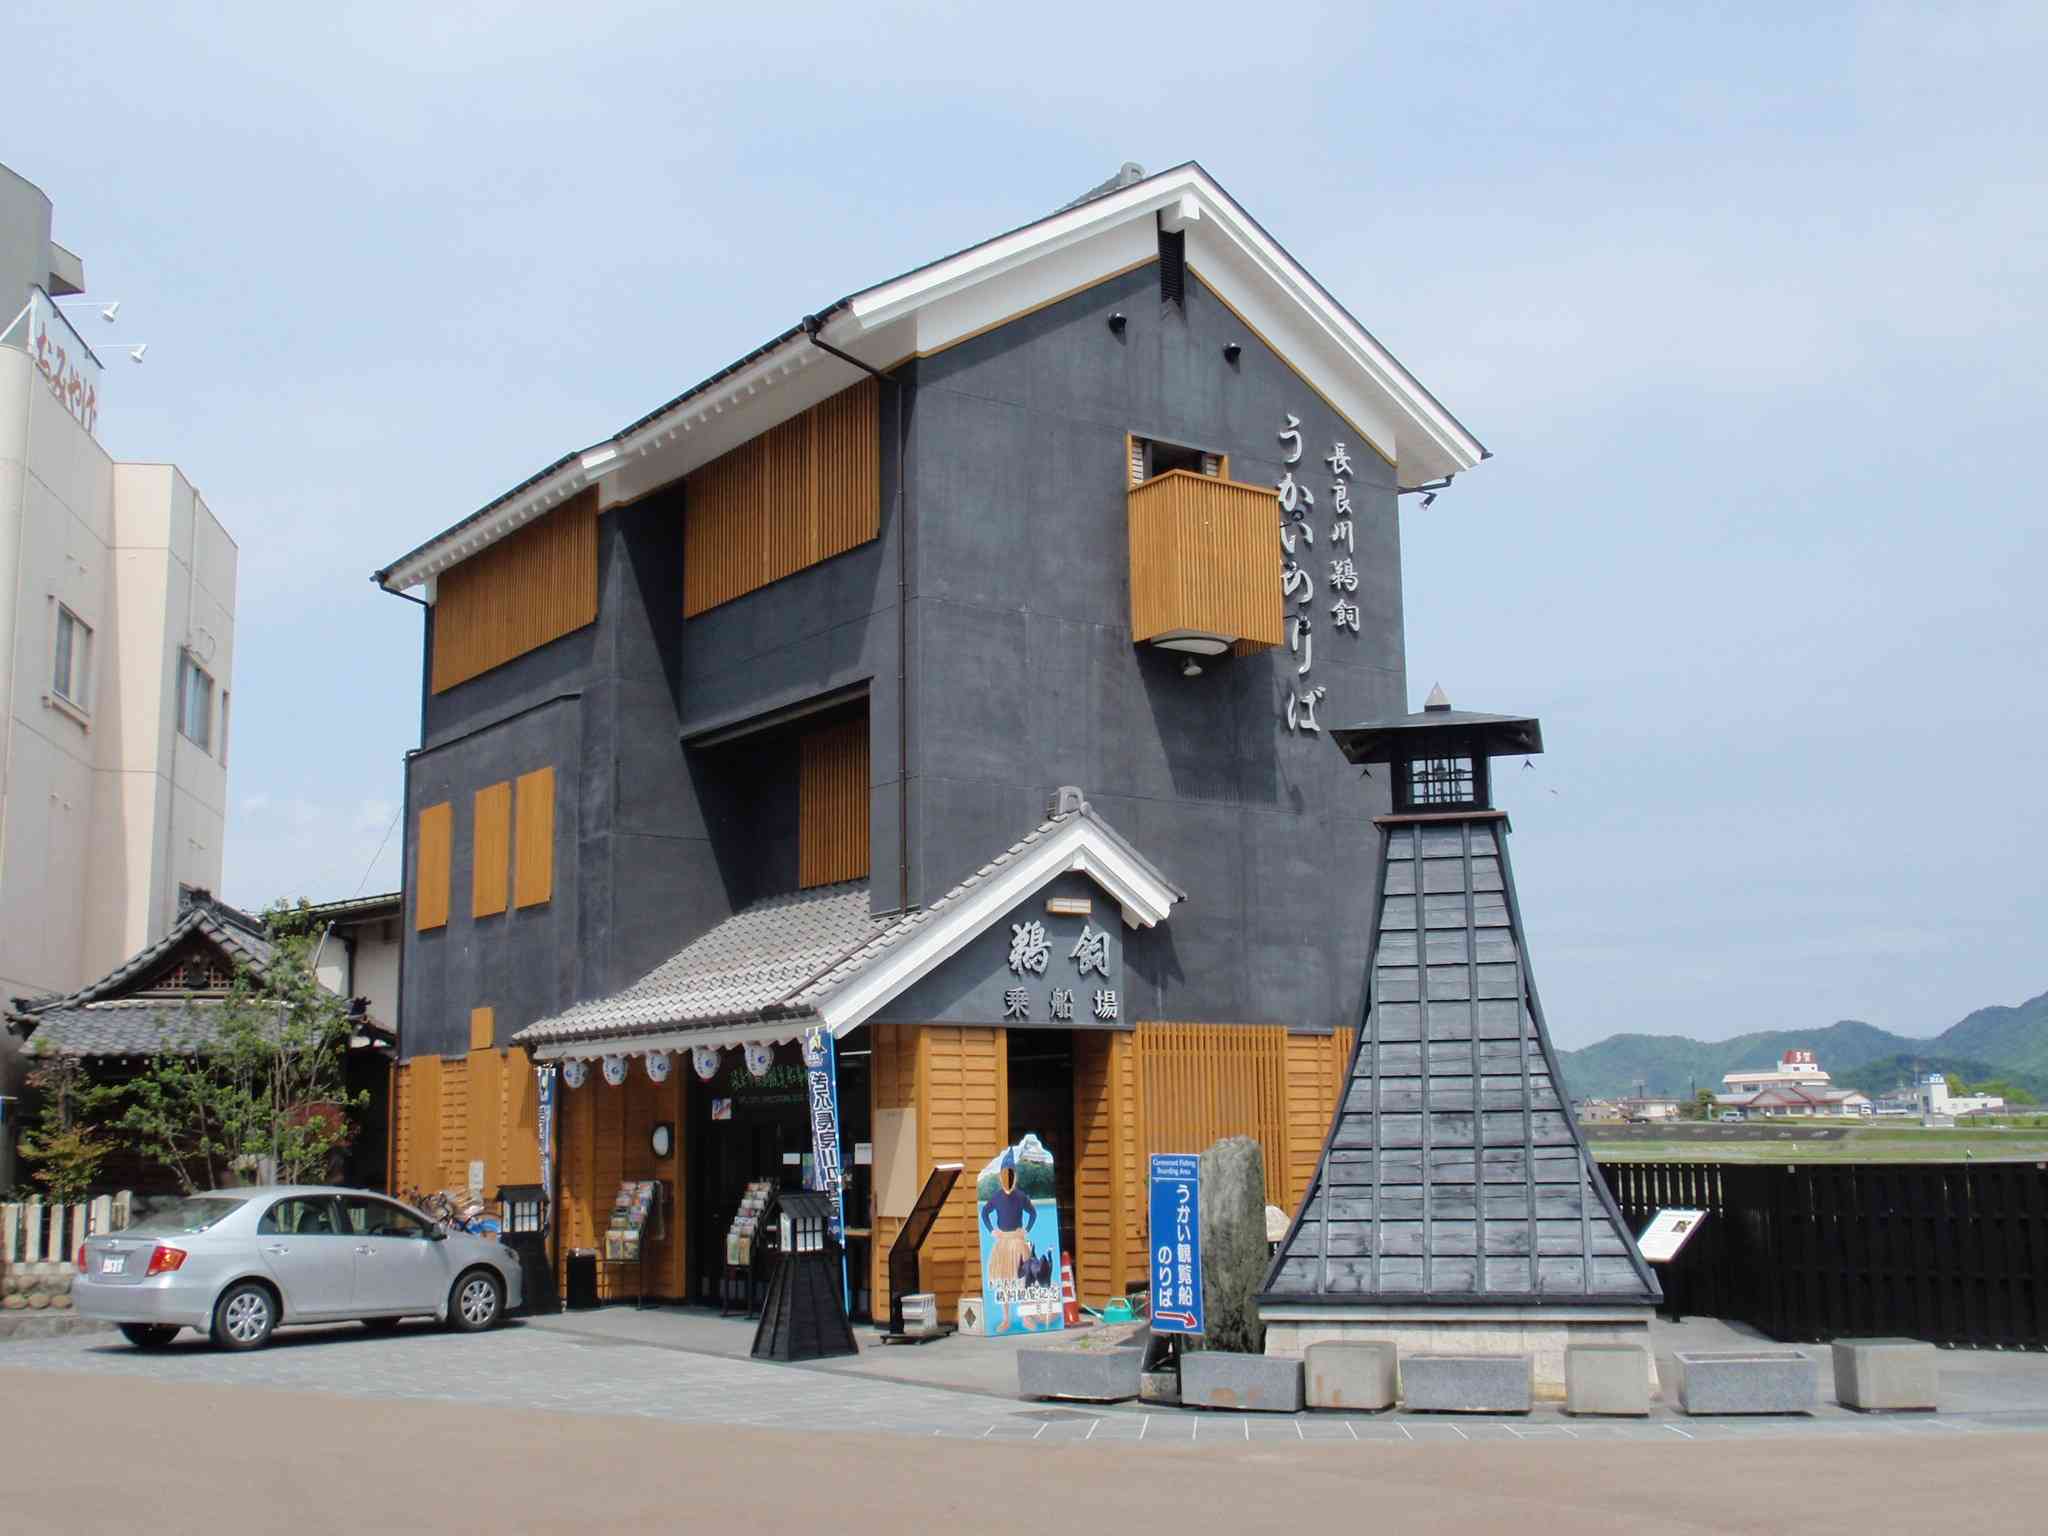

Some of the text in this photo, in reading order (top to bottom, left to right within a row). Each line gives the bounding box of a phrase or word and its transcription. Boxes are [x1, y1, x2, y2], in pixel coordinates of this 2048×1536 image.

[1277, 413, 1326, 732] うかいのりば
[1327, 443, 1360, 632] 長良川鵜飼
[1008, 919, 1111, 977] 鵜飼
[1003, 986, 1119, 1019] 乗船場
[1158, 1246, 1173, 1308] のりば
[1176, 1184, 1193, 1307] うかい観覧船
